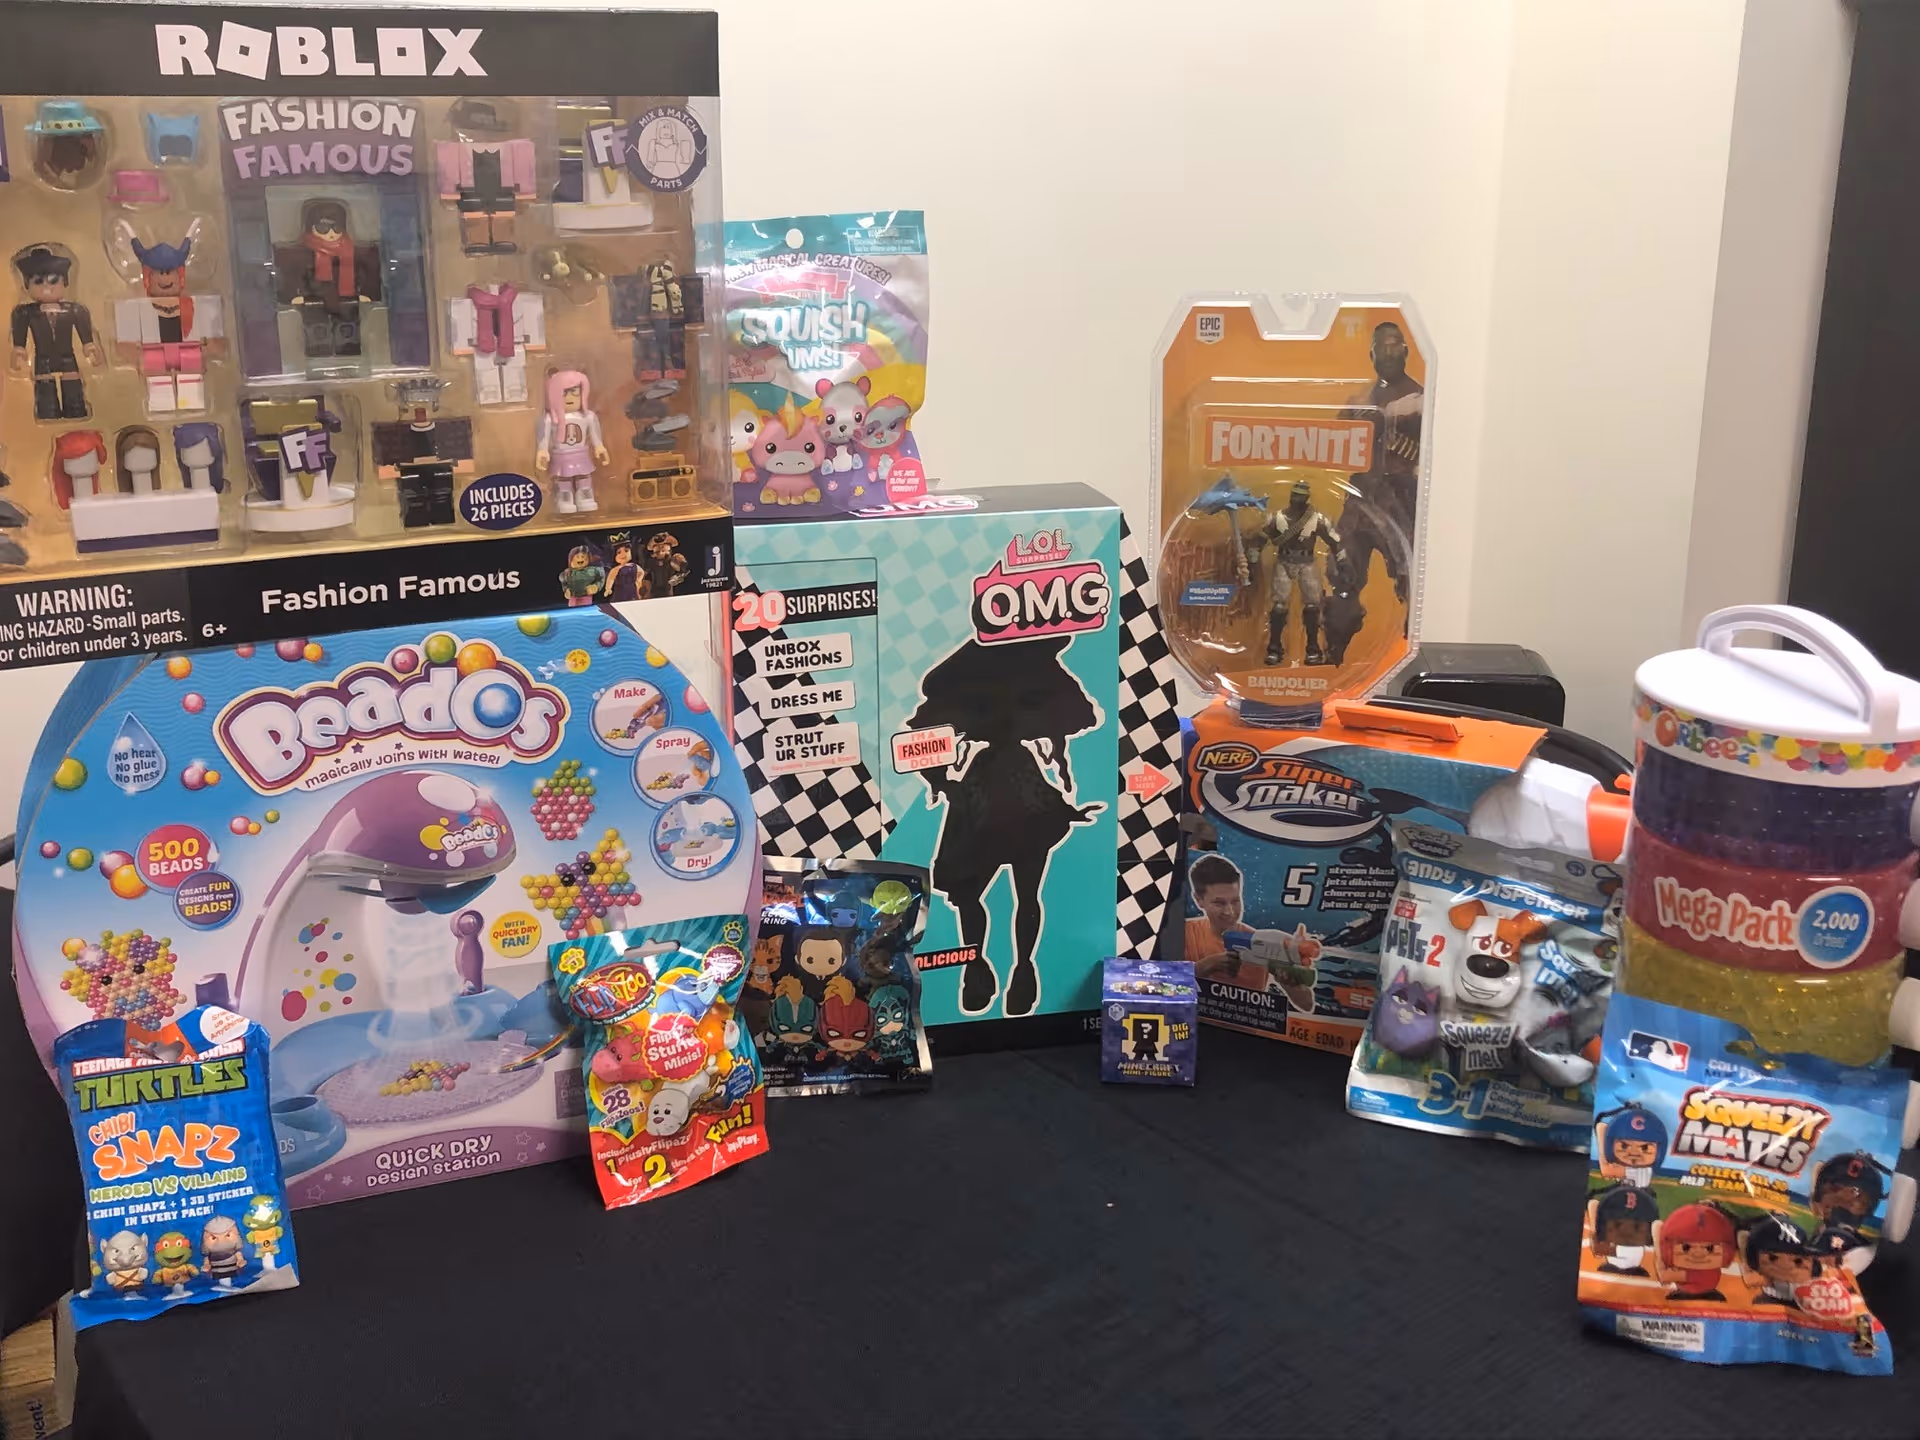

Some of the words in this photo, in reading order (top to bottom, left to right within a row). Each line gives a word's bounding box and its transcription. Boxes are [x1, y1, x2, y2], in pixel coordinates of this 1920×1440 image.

[155, 21, 488, 80] ROBLOX
[223, 100, 416, 140] FASHION
[638, 112, 656, 128] MIX
[667, 108, 699, 133] MATCH
[232, 142, 414, 179] FAMOUS
[650, 176, 683, 189] PARTS
[815, 253, 892, 285] CREATURES!
[741, 301, 868, 344] SQUISH
[1199, 317, 1222, 330] EPIC
[1211, 420, 1369, 468] FORTNITE
[469, 483, 535, 505] INCLUDES
[470, 505, 489, 523] 26
[490, 499, 536, 520] PIECES
[15, 584, 135, 618] WARNING:
[261, 580, 389, 614] Fashion
[399, 567, 521, 600] Famous
[734, 590, 786, 631] 20
[787, 590, 877, 616] SURPRISES!
[28, 617, 85, 639] HAZARD
[141, 608, 186, 628] parts.
[202, 623, 228, 638] 6+
[19, 640, 80, 661] children
[85, 634, 128, 652] under
[131, 631, 140, 648] 3
[143, 629, 188, 651] years.
[764, 640, 821, 658] UNBOX
[765, 651, 843, 672] FASHIONS
[614, 686, 647, 699] Make
[1247, 675, 1328, 690] BANDOLIER
[1285, 688, 1311, 698] Mode
[770, 693, 818, 710] DRESS
[822, 690, 843, 703] ME
[655, 736, 691, 750] Spray
[774, 731, 824, 748] STRUT
[902, 738, 946, 758] FASHION
[114, 752, 129, 763] No
[131, 748, 157, 759] heat
[776, 749, 796, 762] UR
[800, 741, 846, 759] STUFF
[910, 755, 943, 770] DOLL
[1203, 750, 1253, 766] NERF
[115, 773, 130, 784] No
[133, 770, 160, 783] mess
[116, 763, 130, 774] No
[133, 759, 157, 773] glue
[1248, 759, 1360, 790] Super
[1225, 779, 1364, 813] Soaker
[149, 838, 200, 862] 500
[149, 857, 204, 877] BEADS
[687, 855, 713, 868] Dry!
[179, 886, 208, 897] CREATE
[208, 881, 231, 893] FUN
[1283, 867, 1317, 906] 5
[178, 894, 214, 906] DESIGNS
[184, 900, 232, 917] BEADS!
[1657, 878, 1724, 937] Mega
[1728, 898, 1795, 946] Pack
[1811, 909, 1860, 931] 2,000
[493, 928, 520, 940] QUICK
[520, 925, 538, 934] DRY
[504, 920, 525, 929] WITH
[501, 935, 530, 949] FAN!
[1426, 933, 1446, 968] 2
[1210, 983, 1275, 1009] CAUTION:
[1171, 1022, 1189, 1033] DIG
[1174, 1030, 1189, 1041] IN!
[1289, 1026, 1310, 1042] AGE
[1315, 1030, 1345, 1047] EDAD
[1443, 1022, 1512, 1046] Squeeze
[663, 1050, 702, 1072] Minis!
[1117, 1061, 1181, 1073] MINECRAFT
[73, 1057, 248, 1113] TURTLES
[1421, 1071, 1458, 1112] 3
[602, 1088, 631, 1115] 28
[705, 1104, 754, 1144] Fun!
[1685, 1091, 1828, 1141] SQUEEZY
[89, 1112, 136, 1145] CHIBI
[93, 1123, 240, 1181] SNAPZ
[449, 1134, 493, 1158] DRY
[596, 1144, 635, 1161] Includes
[1677, 1120, 1812, 1173] MATES
[643, 1153, 673, 1188] 2
[89, 1182, 151, 1204] HEROES
[152, 1175, 179, 1196] VS
[179, 1166, 247, 1192] VILLAINS
[93, 1206, 126, 1220] CHIBI
[129, 1200, 167, 1214] SNAPZ
[207, 1186, 254, 1203] STICKER
[124, 1216, 138, 1228] IN
[141, 1210, 179, 1225] EVERY
[181, 1205, 215, 1219] PACK!
